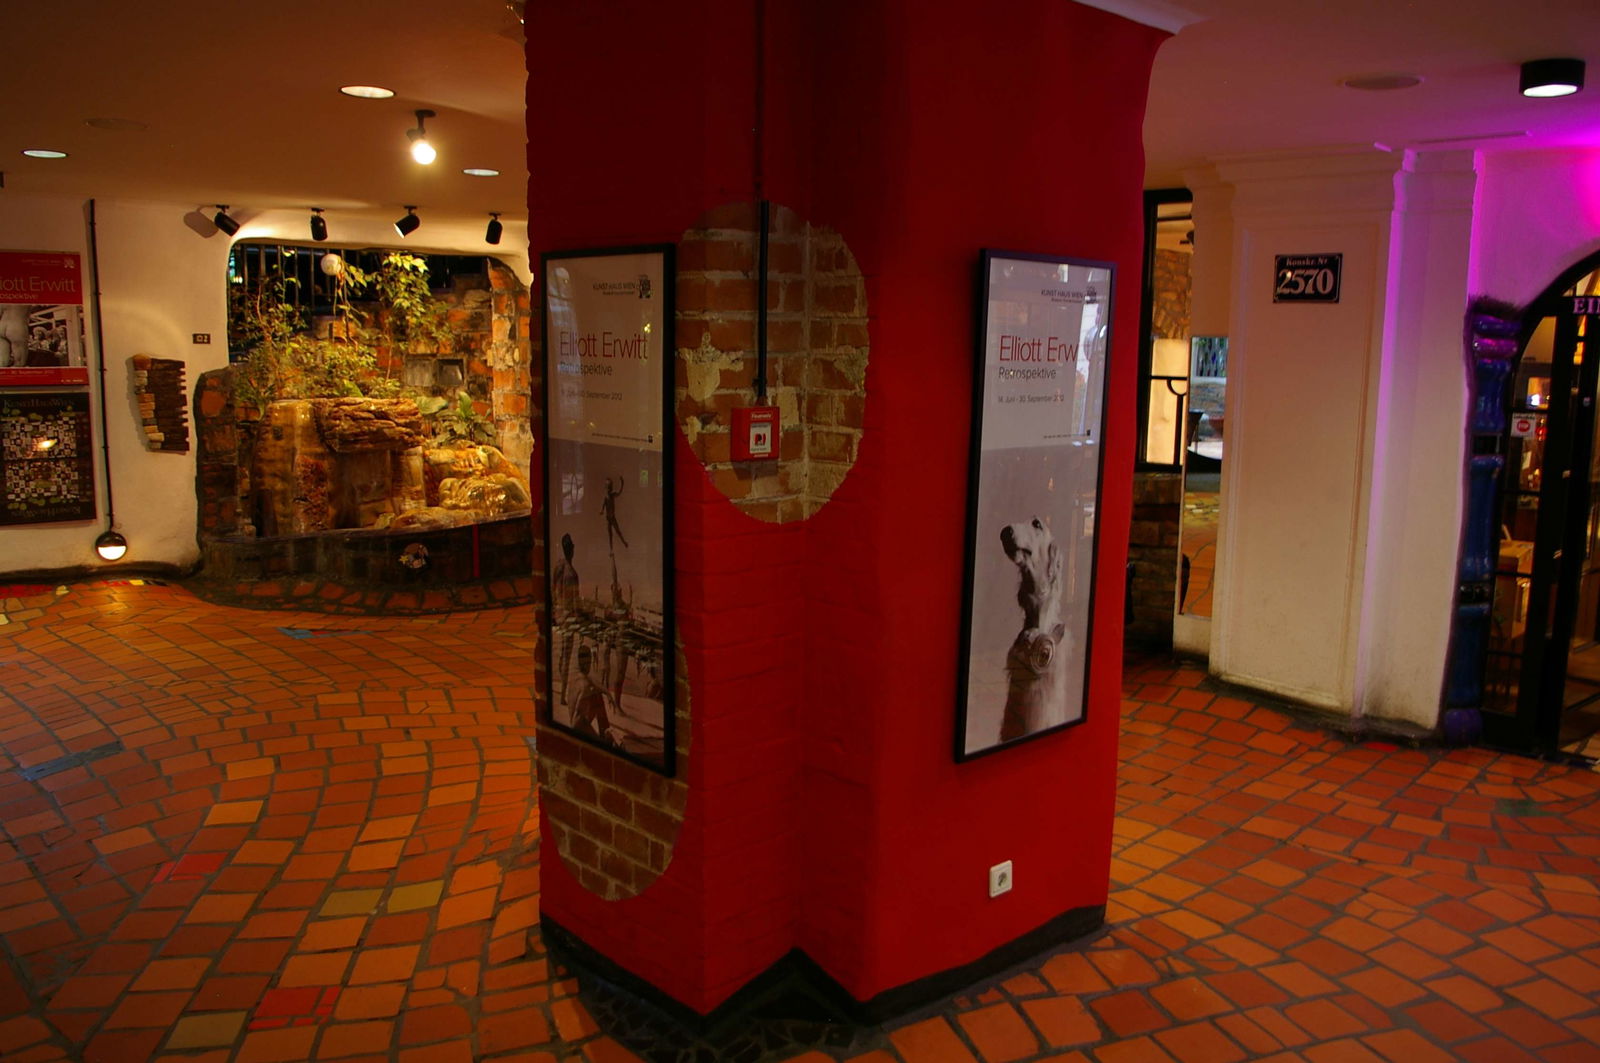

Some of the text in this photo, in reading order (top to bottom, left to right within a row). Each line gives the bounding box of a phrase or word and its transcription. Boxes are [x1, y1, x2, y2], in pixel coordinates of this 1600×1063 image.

[29, 276, 76, 293] Erwitt
[1277, 268, 1334, 295] 2570
[560, 331, 648, 359] Elliott Erwitt
[999, 335, 1042, 362] Elliott
[998, 366, 1057, 382] Retrospektive
